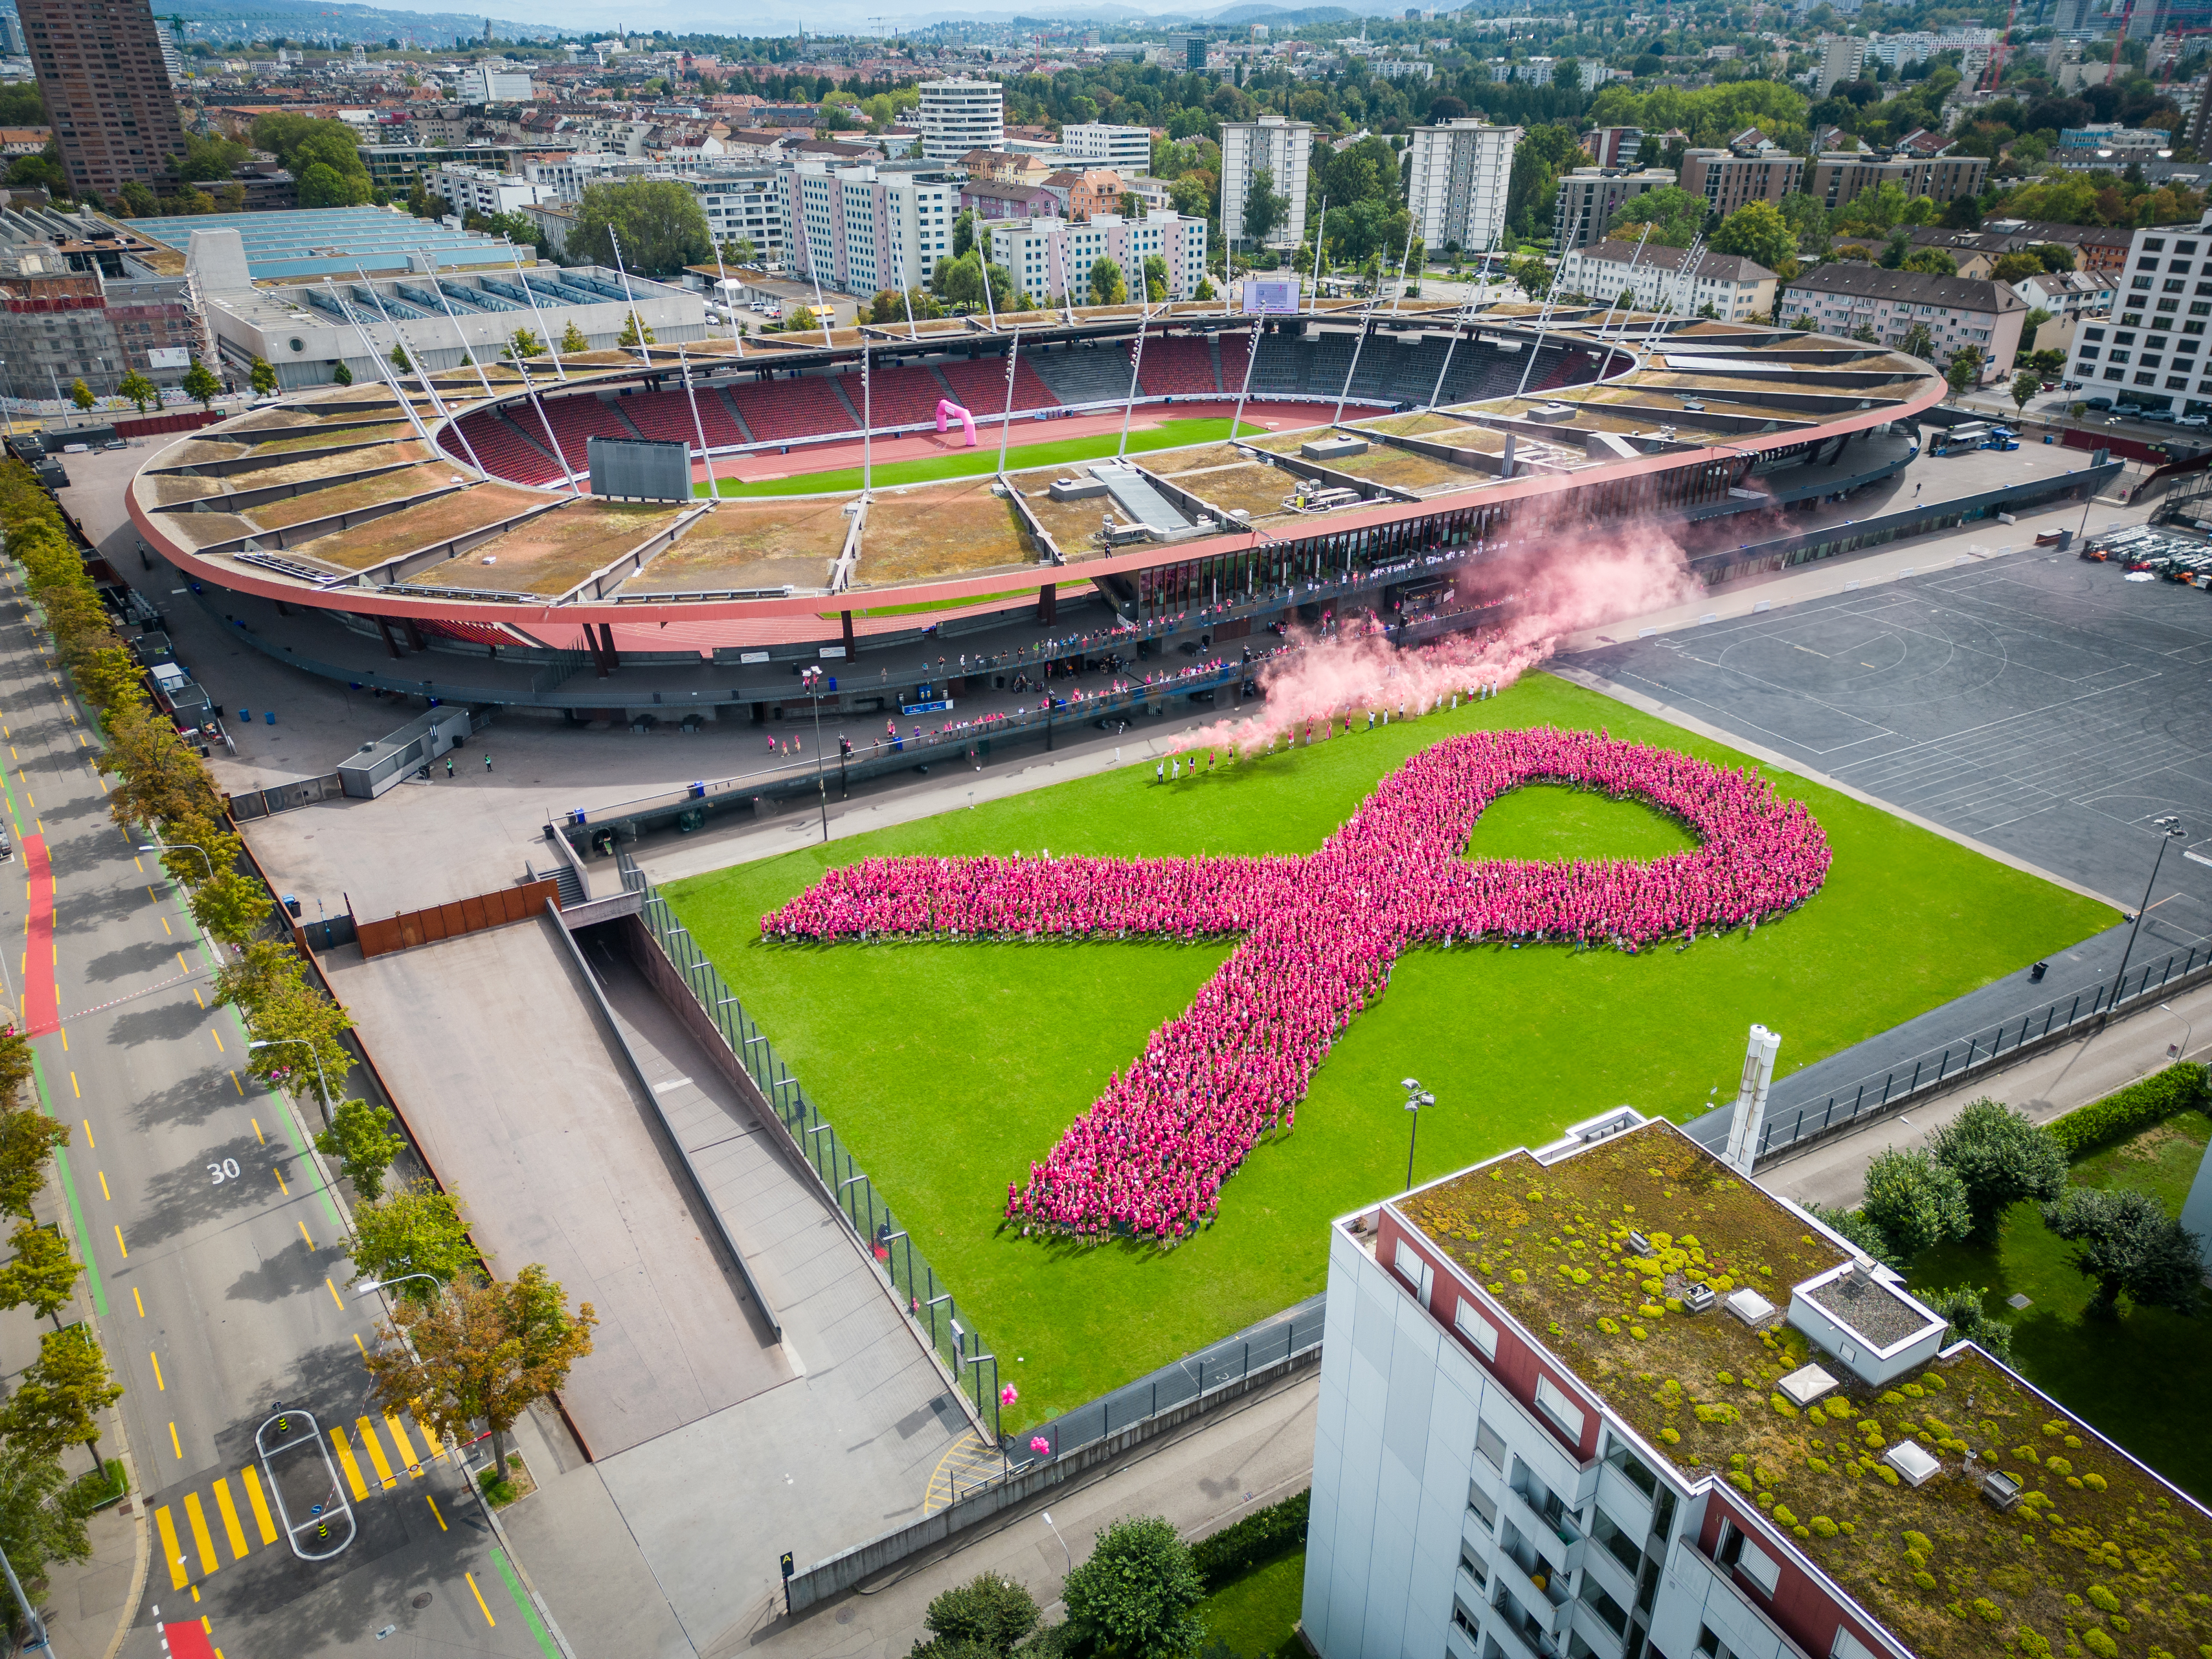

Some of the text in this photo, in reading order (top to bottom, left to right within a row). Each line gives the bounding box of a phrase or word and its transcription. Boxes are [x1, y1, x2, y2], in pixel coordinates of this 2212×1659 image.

[1111, 594, 1121, 613] OVAL
[206, 1158, 240, 1184] 30
[782, 1555, 792, 1564] A
